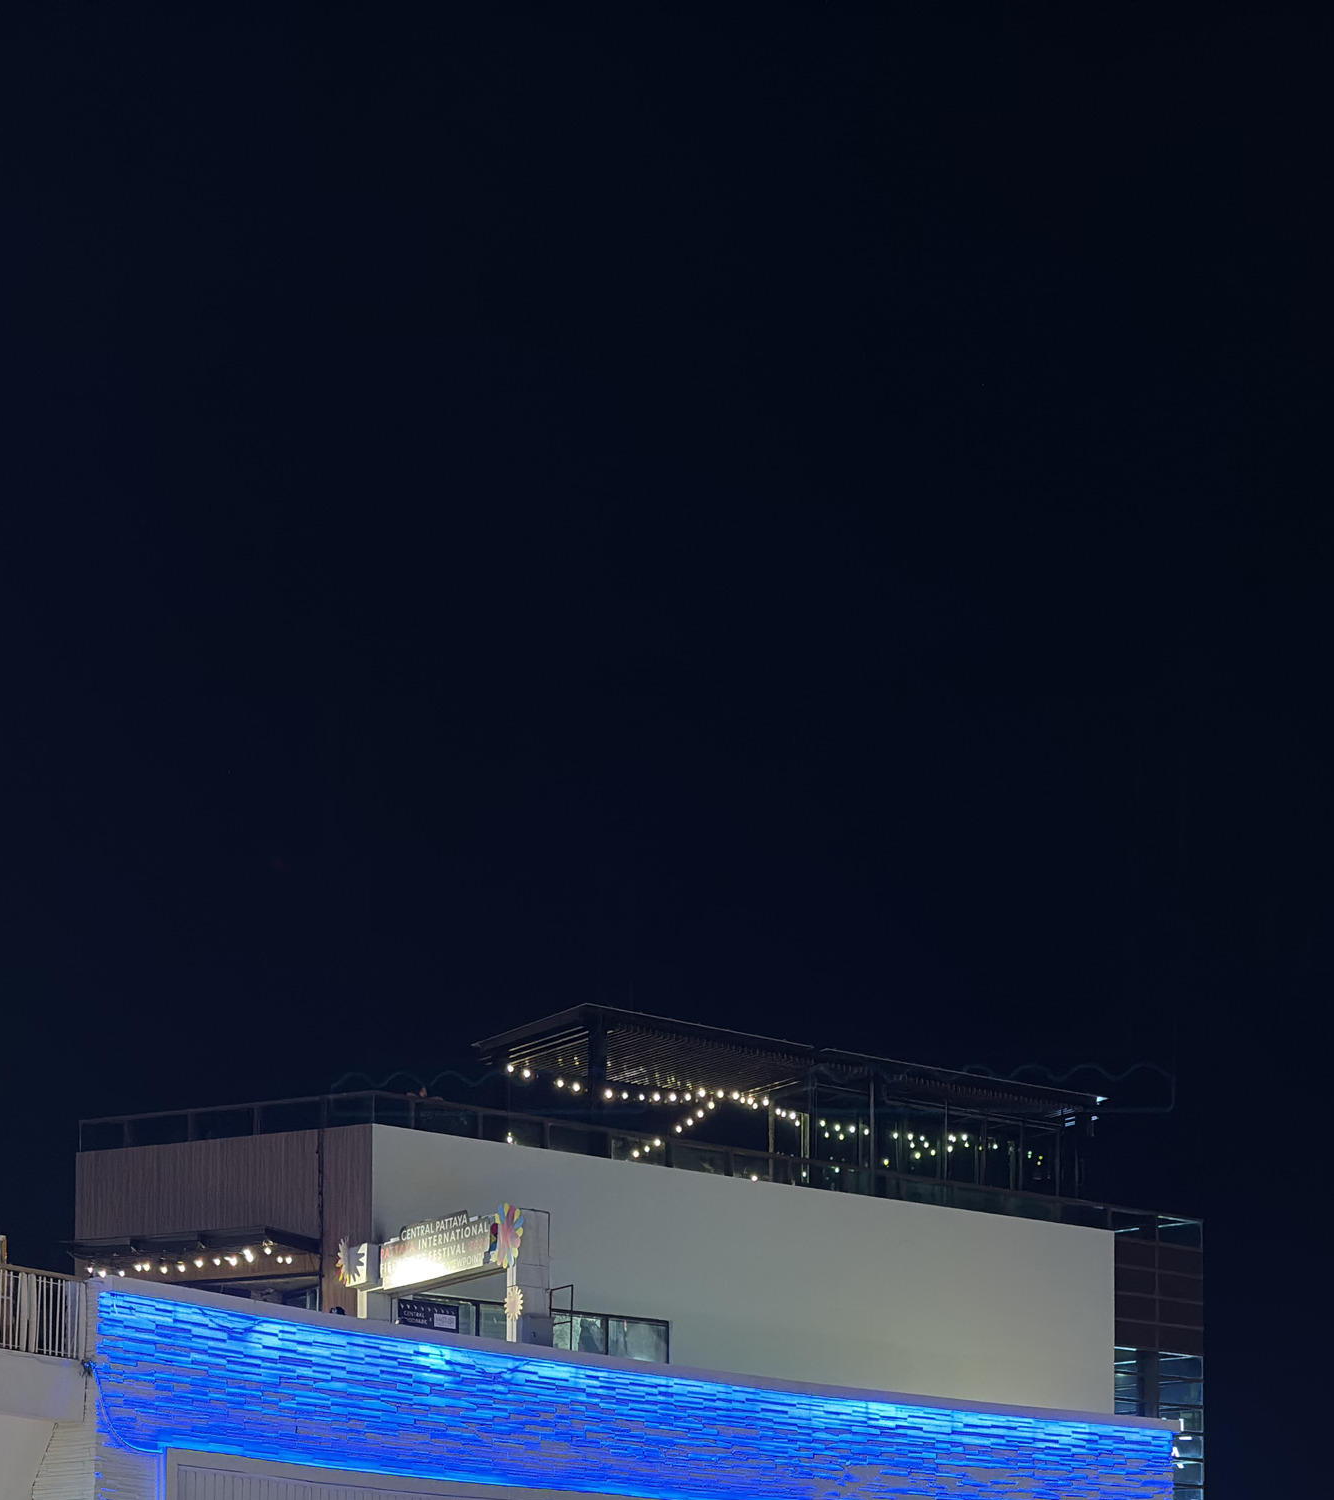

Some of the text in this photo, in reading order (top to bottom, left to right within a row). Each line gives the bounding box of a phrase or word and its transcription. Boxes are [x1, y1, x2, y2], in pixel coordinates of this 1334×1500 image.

[401, 1214, 467, 1241] CENTRAL PATTAYA
[418, 1222, 488, 1249] INTERNATIONAL
